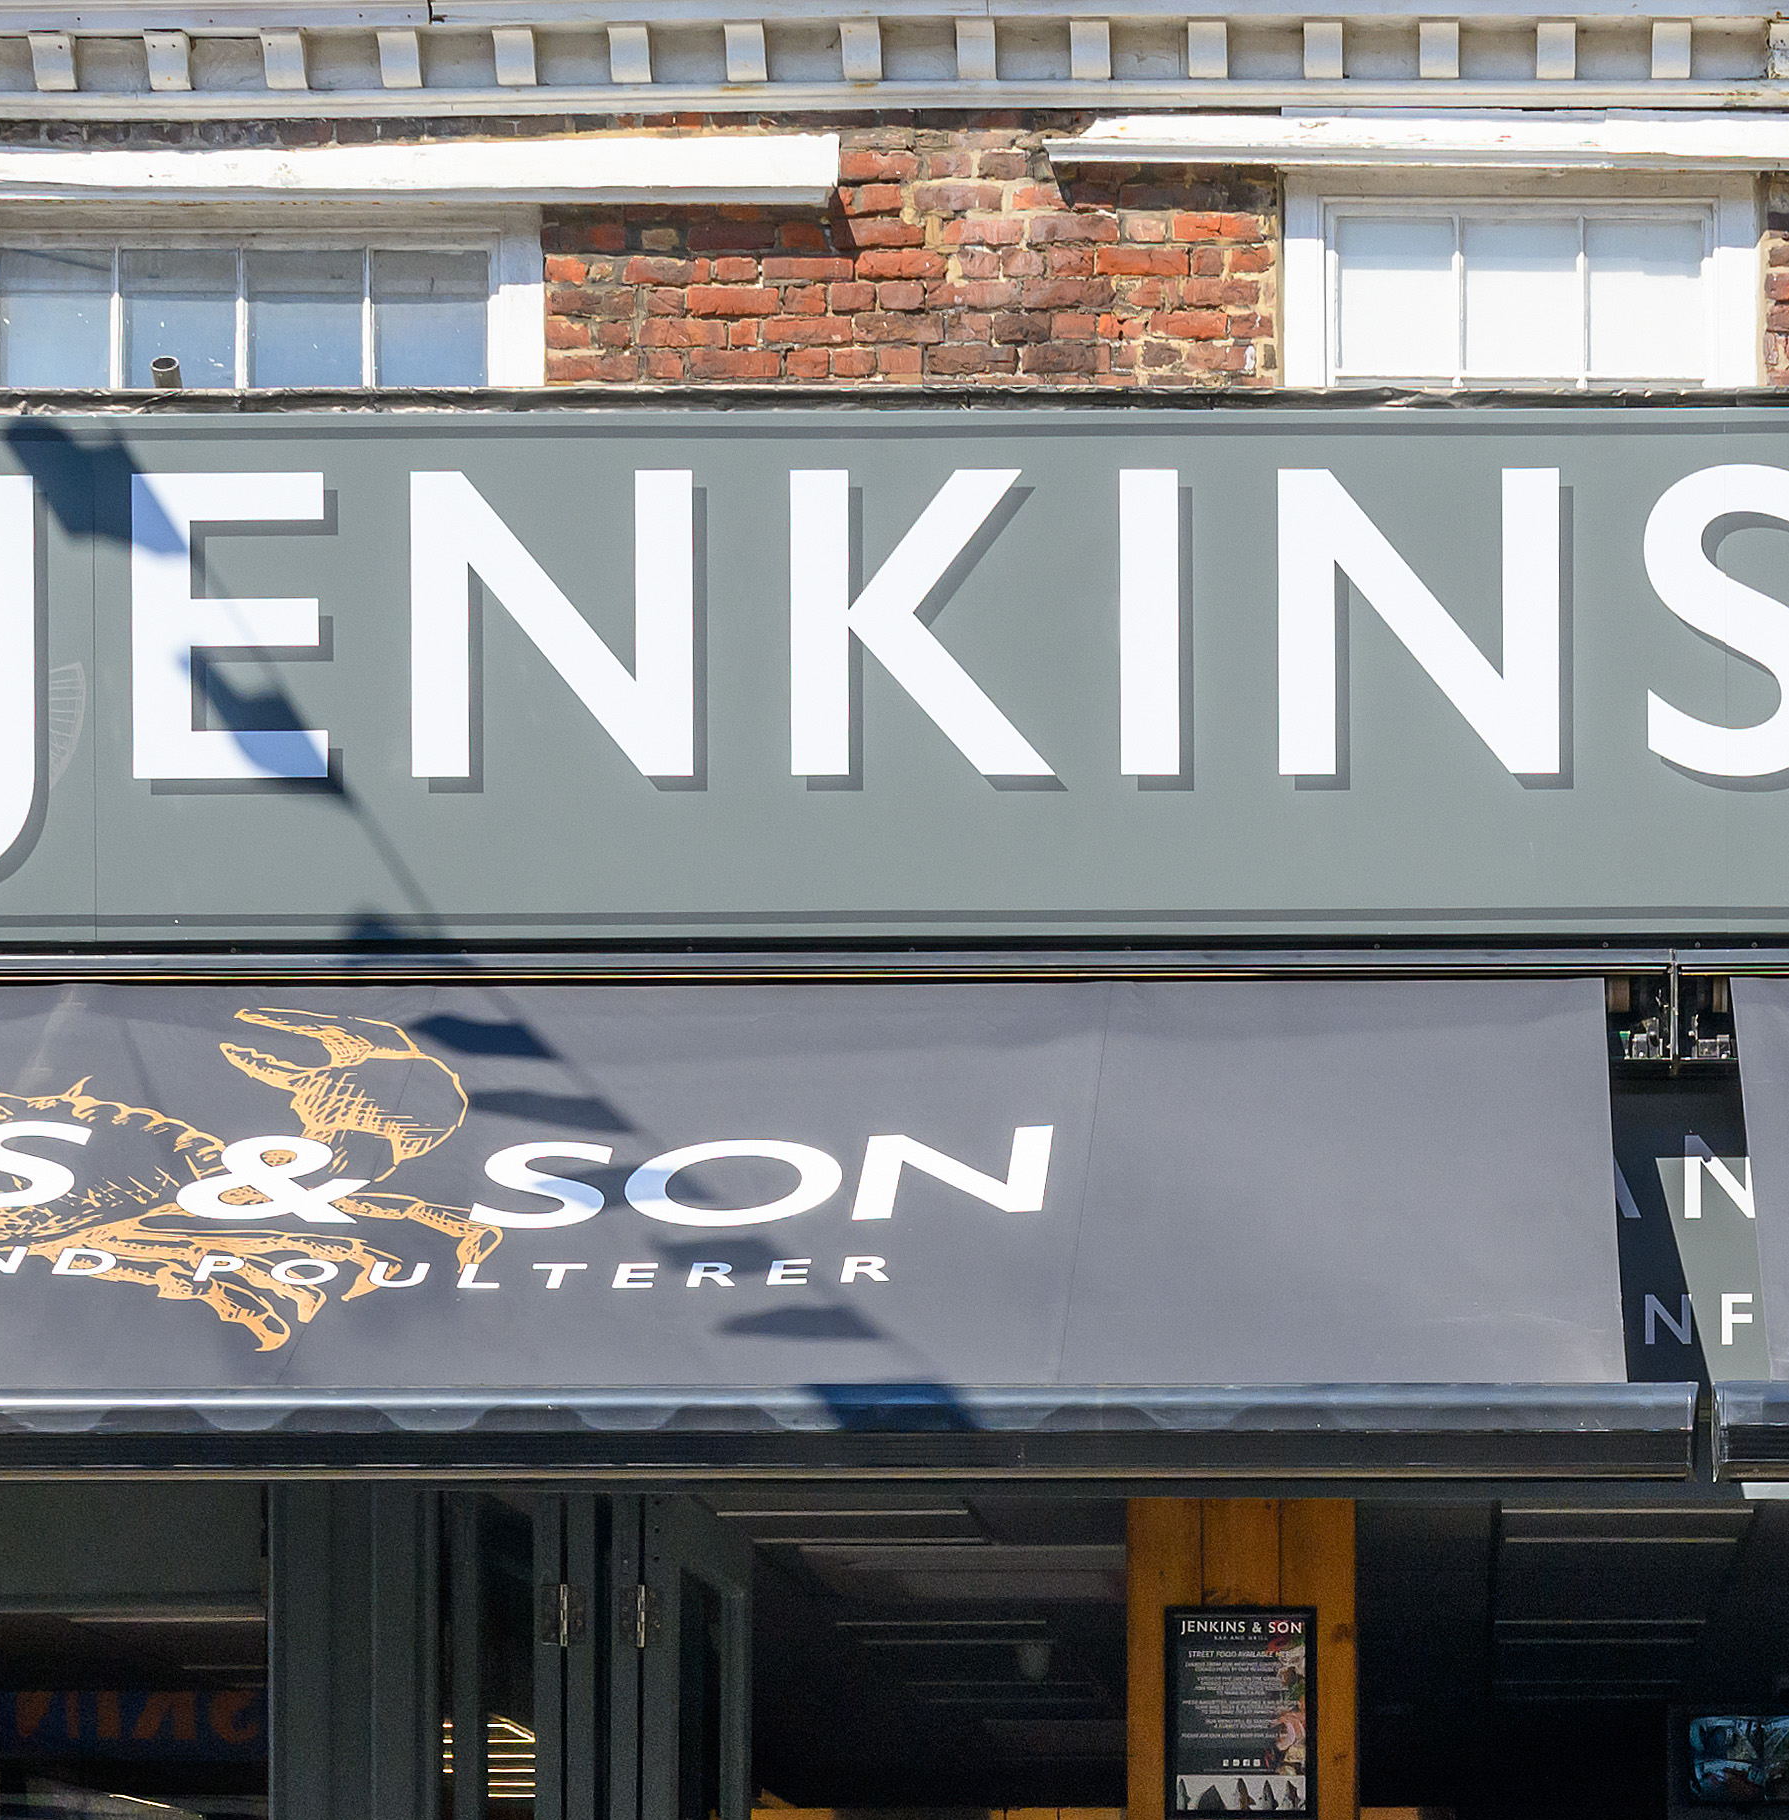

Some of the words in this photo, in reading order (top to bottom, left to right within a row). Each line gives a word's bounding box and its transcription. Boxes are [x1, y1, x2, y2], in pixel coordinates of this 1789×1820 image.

[174, 1133, 373, 1225] &
[468, 1124, 1055, 1230] SON
[191, 1255, 892, 1291] POULTERER
[1180, 1620, 1246, 1635] JENKINS
[1252, 1621, 1262, 1633] &
[1268, 1621, 1303, 1634] SON
